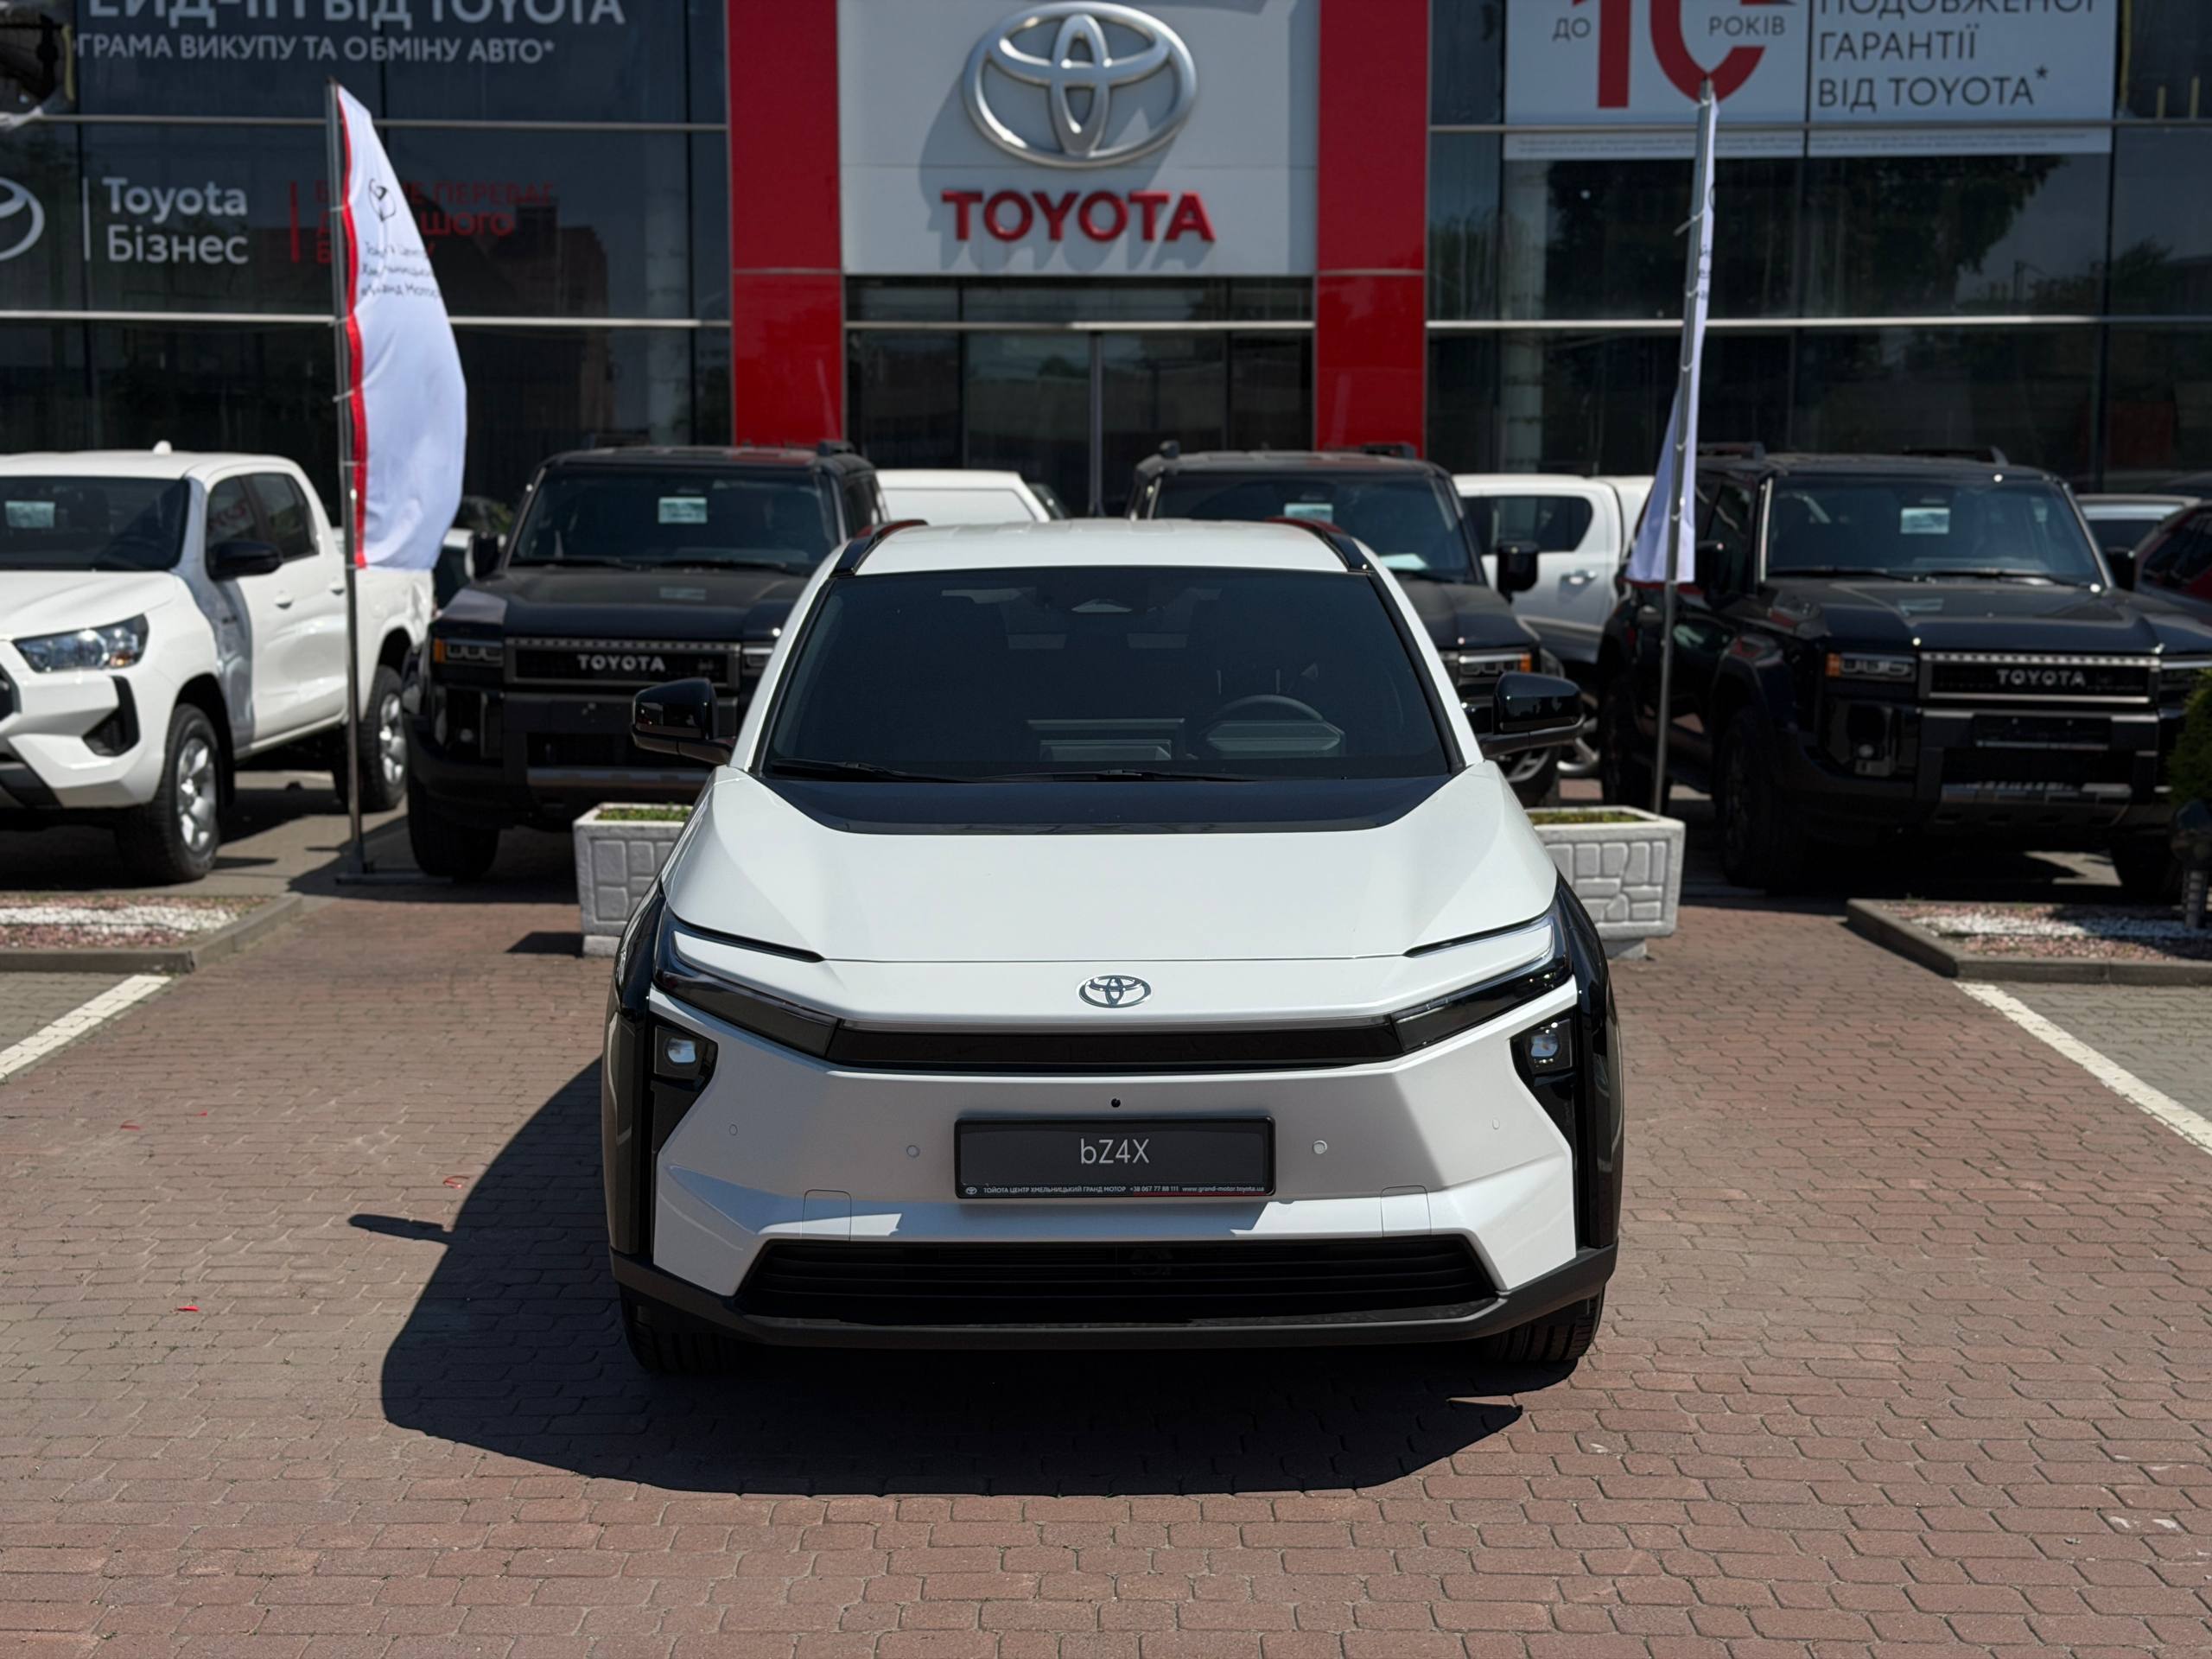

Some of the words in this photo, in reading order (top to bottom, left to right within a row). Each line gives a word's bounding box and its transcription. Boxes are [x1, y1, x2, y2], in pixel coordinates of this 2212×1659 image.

[1553, 18, 1592, 41] ДО
[1708, 16, 1786, 36] РОКІВ
[1819, 23, 1980, 61] ГАРАНТІЇ
[74, 33, 173, 59] ГРАМА
[180, 34, 297, 60] ВИКУПУ
[303, 36, 338, 60] ТА
[344, 36, 461, 62] ОБМІНУ
[1818, 79, 1877, 113] ВІД
[102, 176, 248, 225] Toyota
[941, 190, 1217, 243] TOYOTA
[107, 225, 250, 265] Бізнес
[577, 654, 665, 672] TOYOTA
[1997, 669, 2086, 687] TOYOTA
[1080, 1138, 1150, 1165] bZ4X
